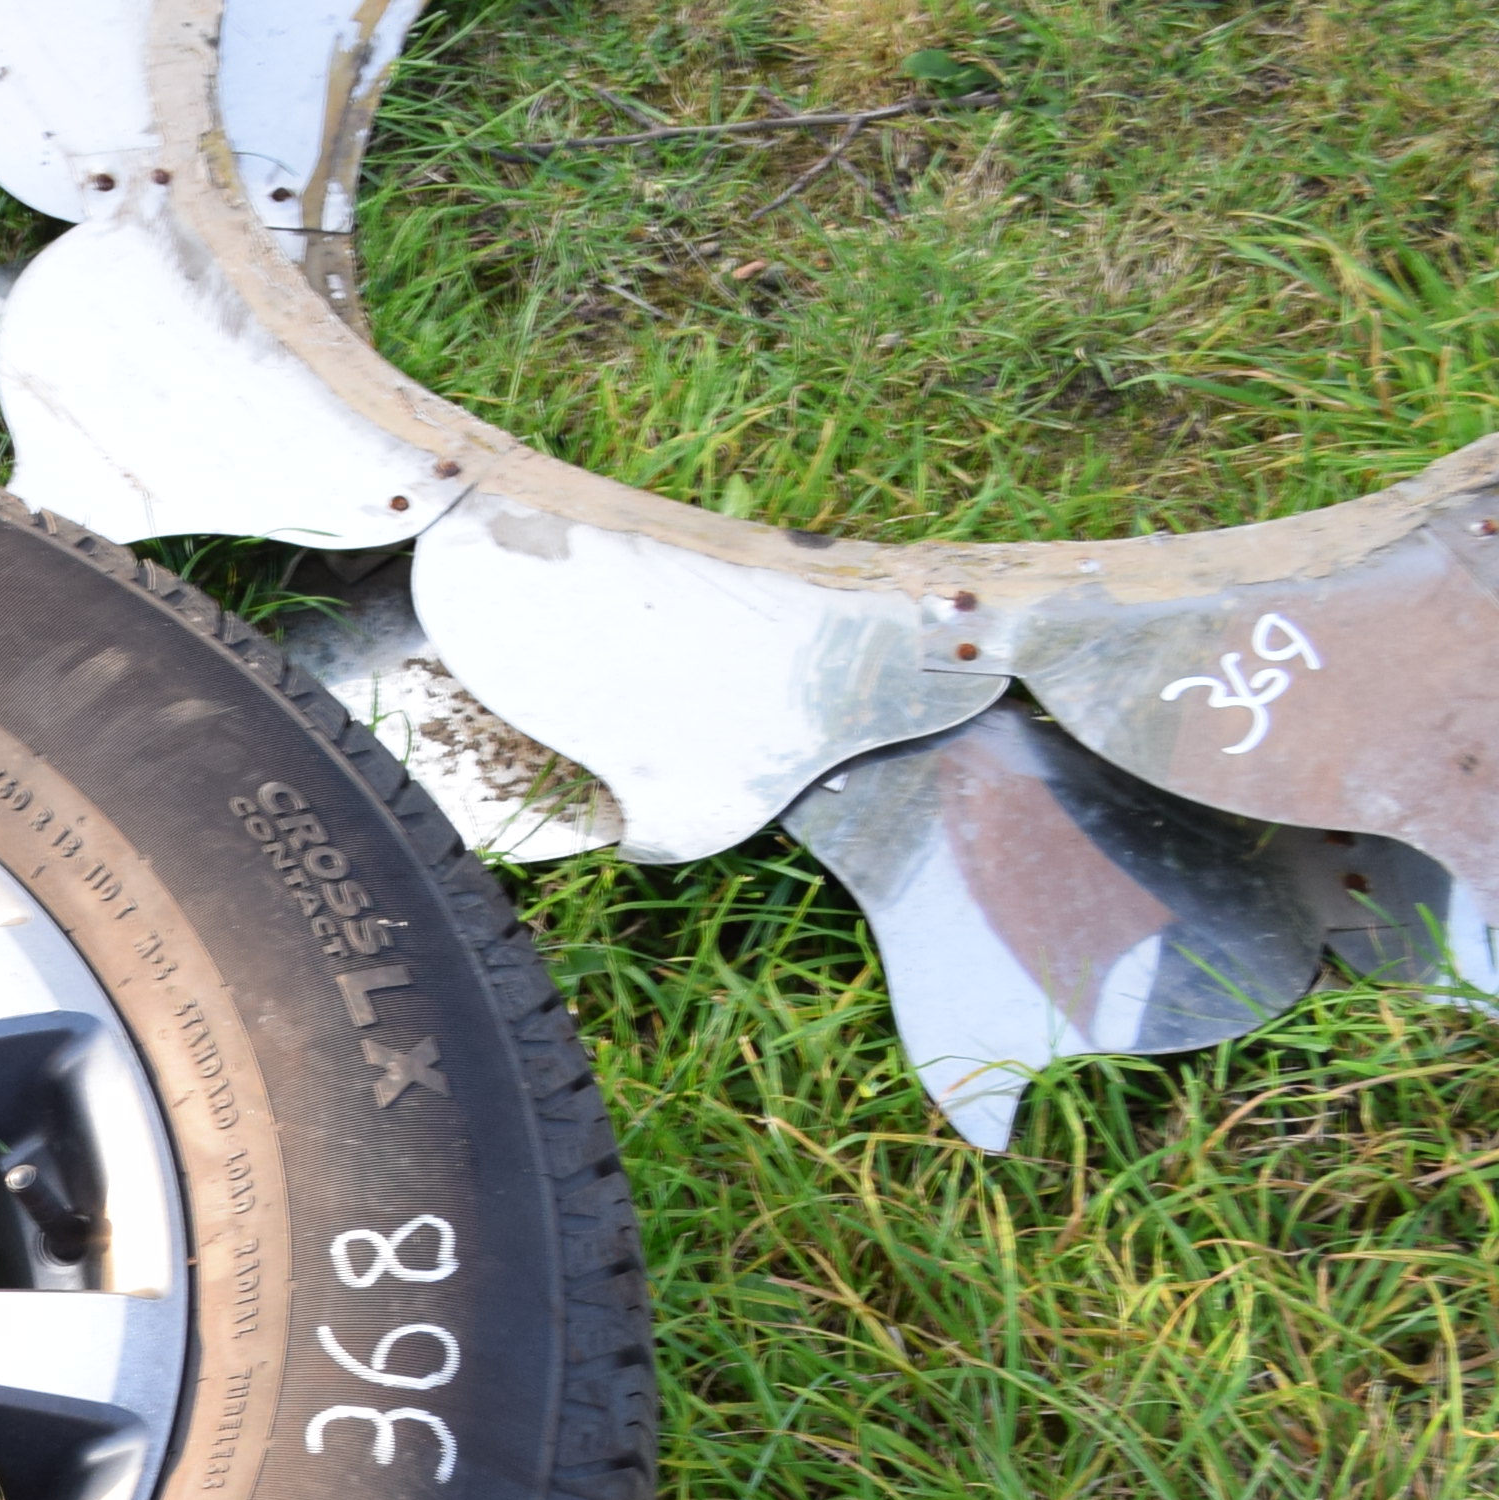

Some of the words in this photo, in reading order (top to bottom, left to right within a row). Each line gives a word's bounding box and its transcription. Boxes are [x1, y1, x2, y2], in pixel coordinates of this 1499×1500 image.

[1160, 612, 1323, 756] 369
[228, 796, 350, 959] CONTACT
[257, 780, 395, 956] CROSS
[172, 999, 240, 1131] STANDARD
[222, 1149, 256, 1215] LOAD
[230, 1237, 260, 1340] RADIAL
[304, 1213, 462, 1485] 368
[200, 1367, 252, 1490] TUBELESS
